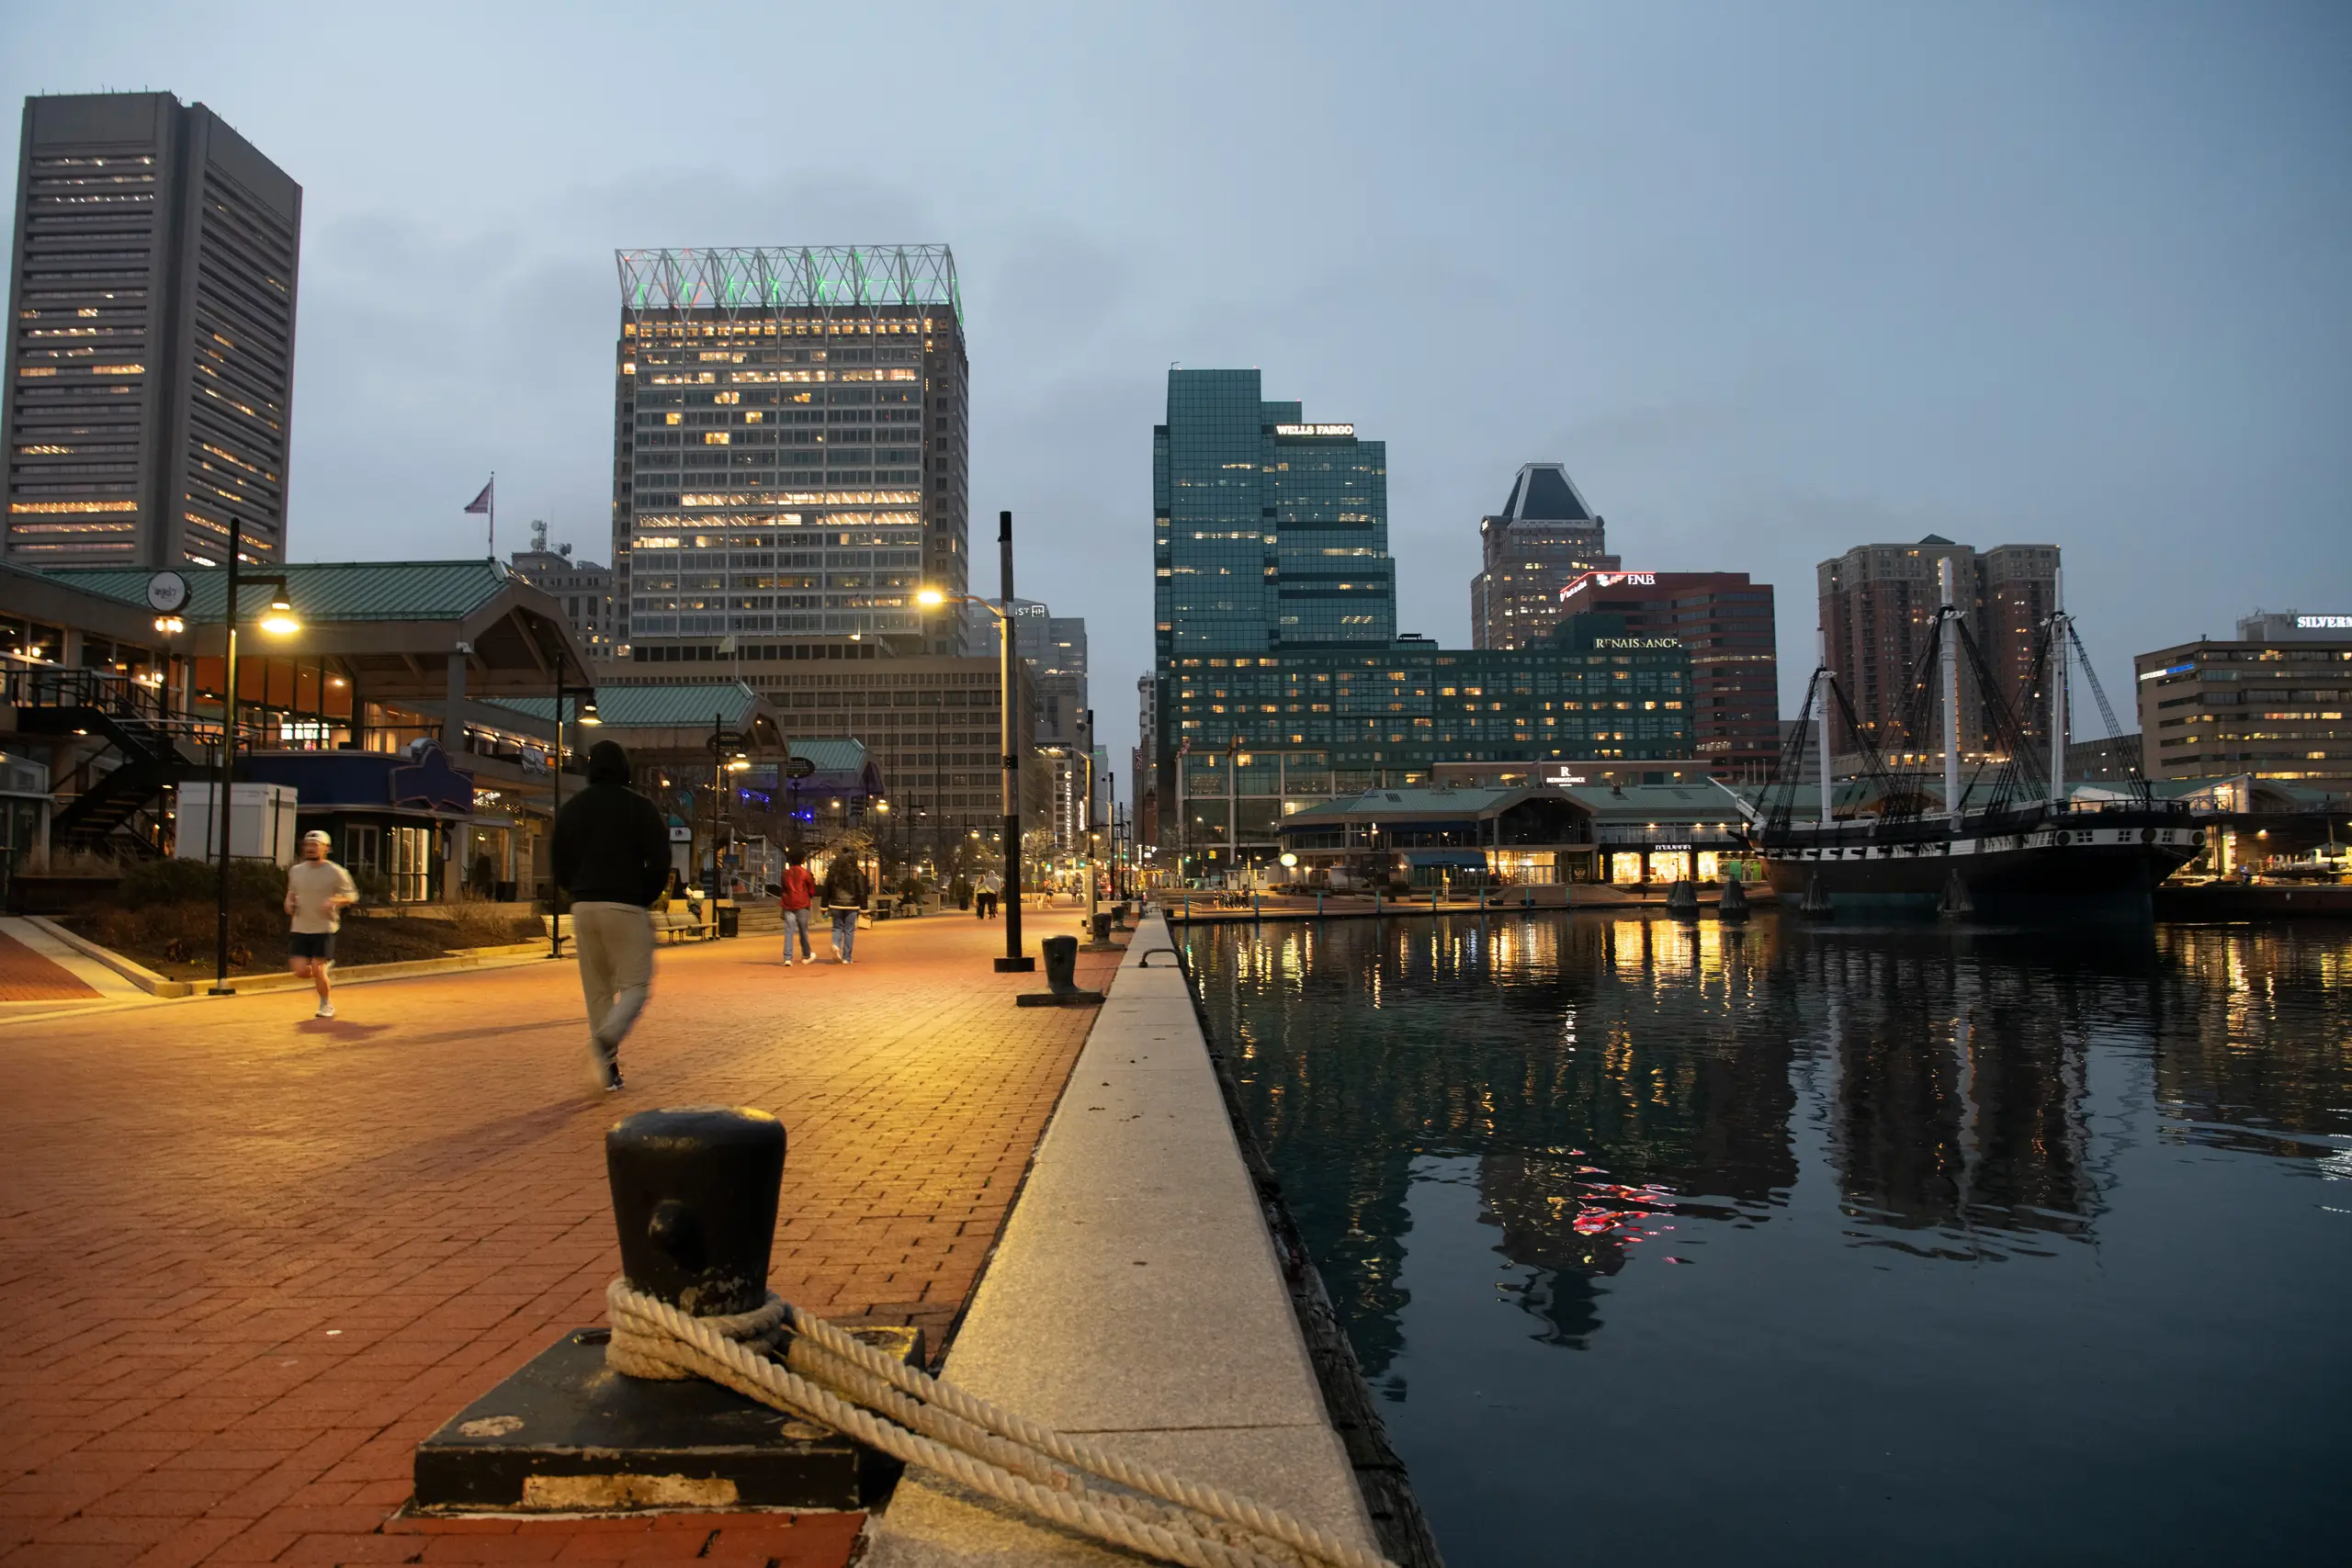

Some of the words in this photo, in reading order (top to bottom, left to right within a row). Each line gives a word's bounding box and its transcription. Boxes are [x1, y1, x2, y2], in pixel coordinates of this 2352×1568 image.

[1276, 425, 1314, 435] WELLS
[1316, 425, 1353, 435] FARGO
[1560, 766, 1571, 777] R
